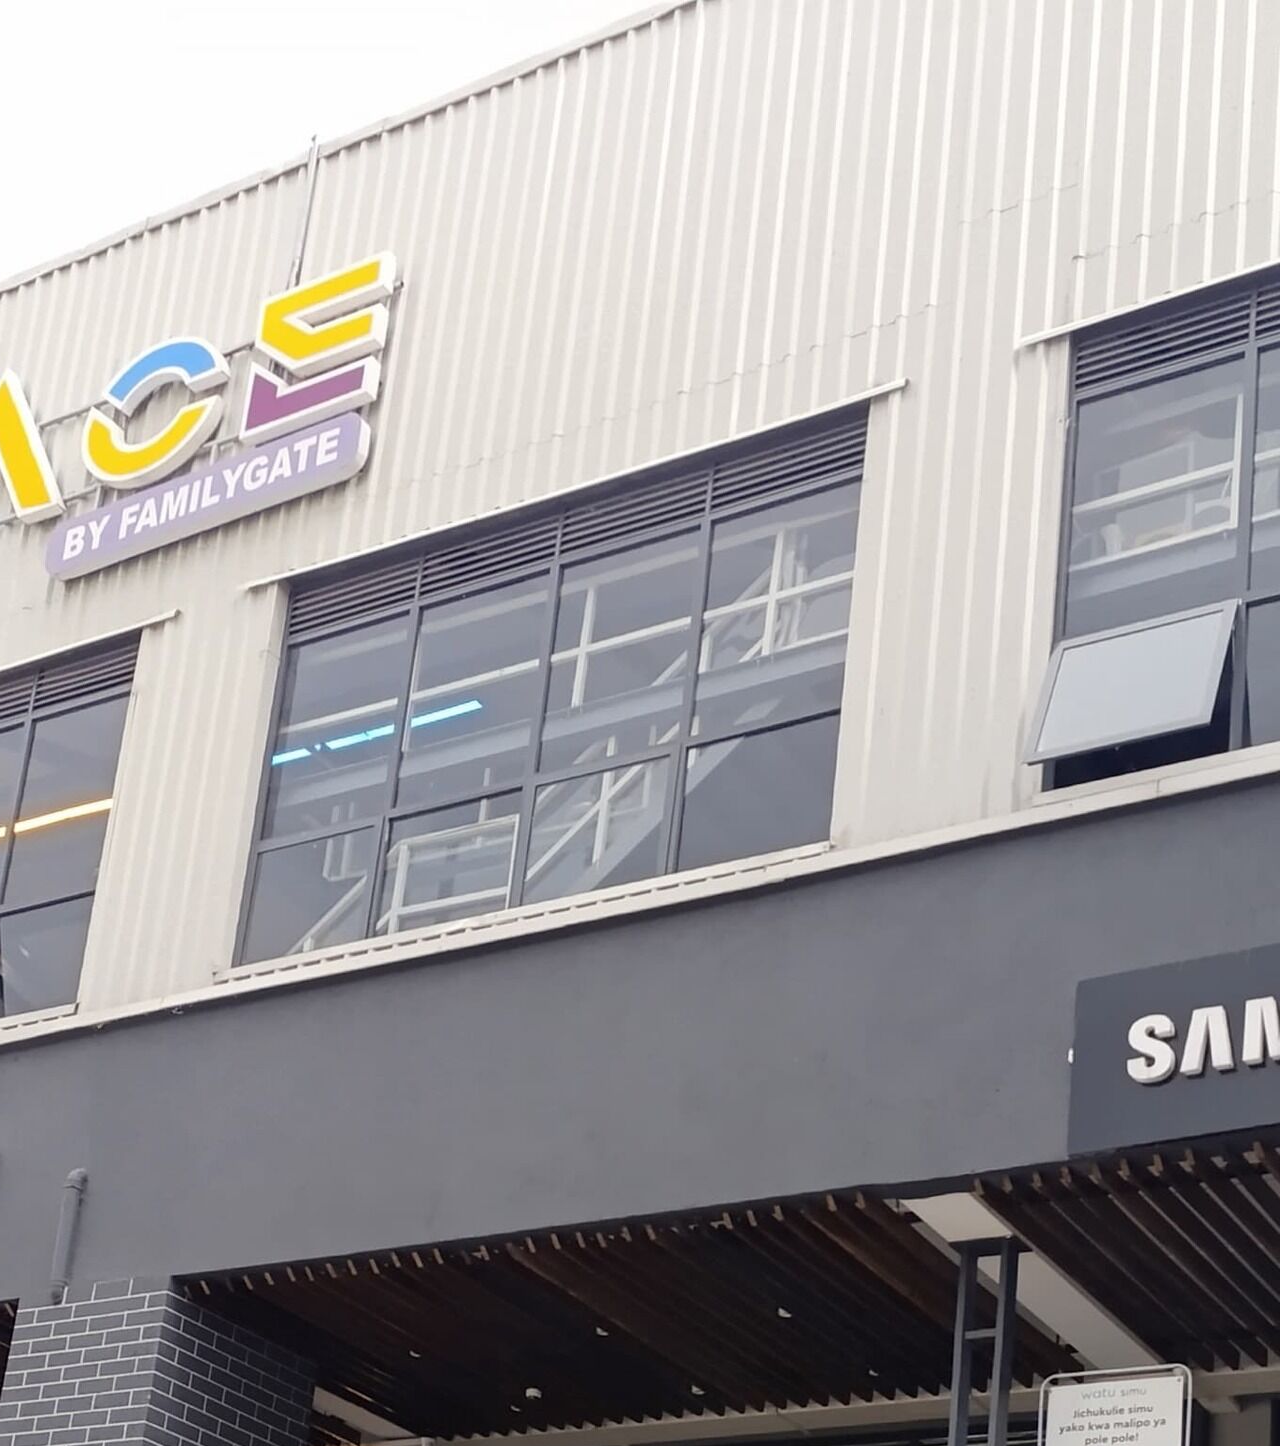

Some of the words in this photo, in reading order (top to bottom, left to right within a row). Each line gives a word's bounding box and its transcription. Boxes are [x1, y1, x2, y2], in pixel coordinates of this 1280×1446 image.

[60, 515, 108, 560] BY
[119, 429, 342, 536] FAMILYGATE
[1081, 1388, 1116, 1400] watu
[1120, 1387, 1147, 1397] simu
[1128, 1404, 1154, 1413] simu
[1059, 1422, 1085, 1435] yako
[1088, 1421, 1110, 1431] kwa
[1113, 1418, 1151, 1429] malipo
[1153, 1417, 1167, 1428] ya
[1085, 1434, 1108, 1446] pole
